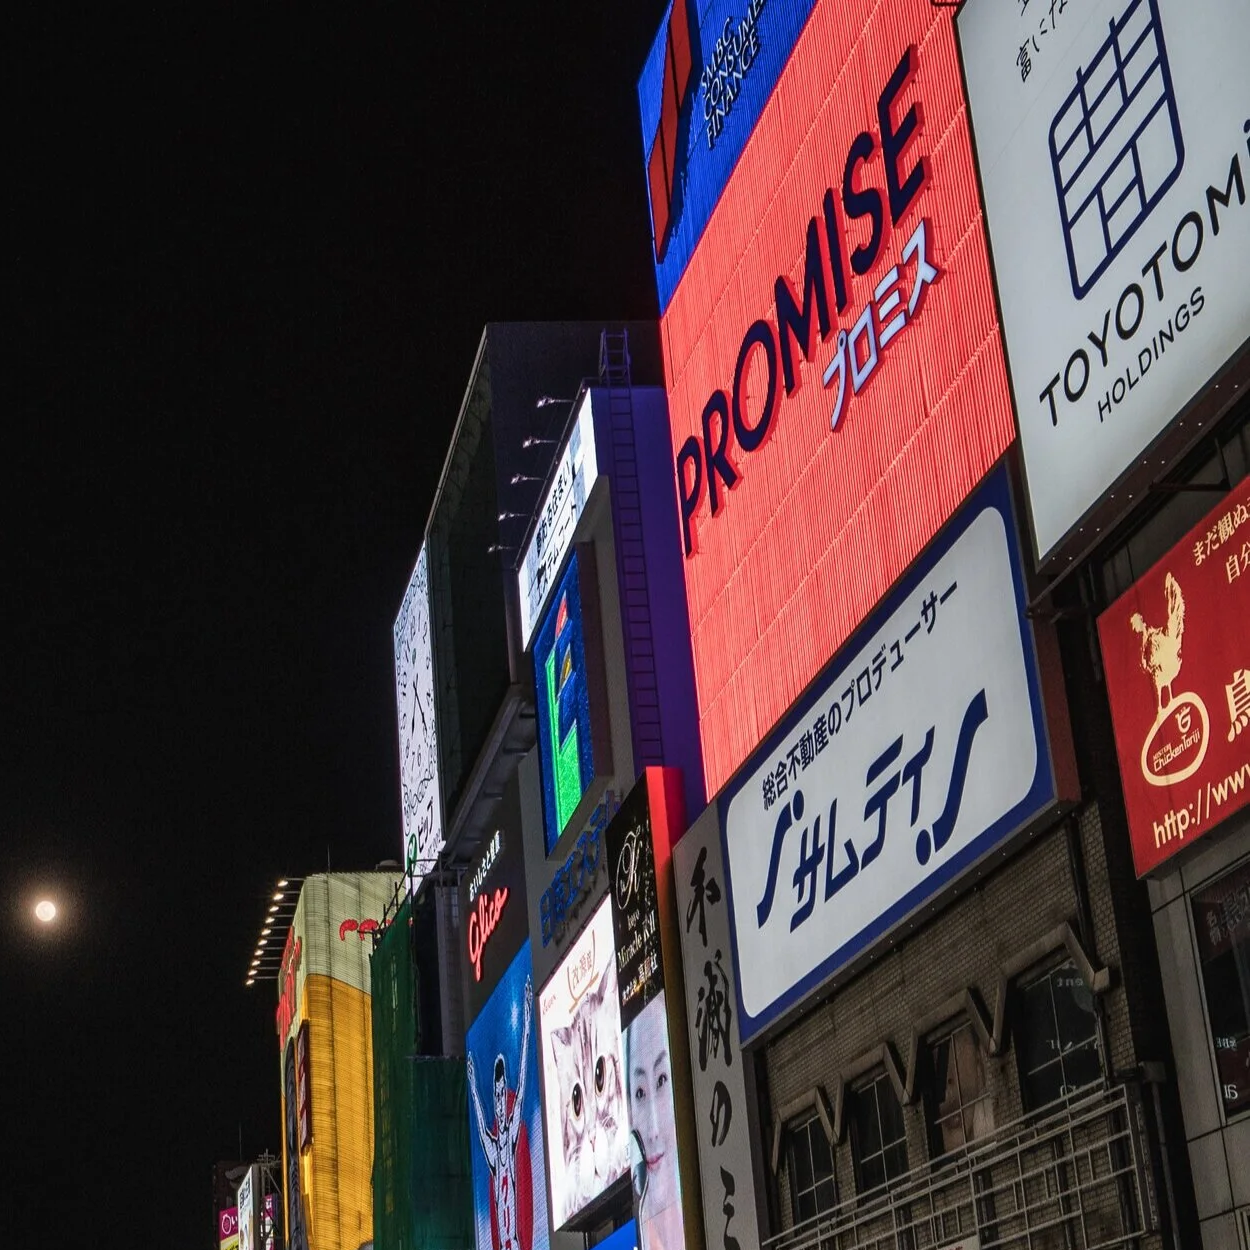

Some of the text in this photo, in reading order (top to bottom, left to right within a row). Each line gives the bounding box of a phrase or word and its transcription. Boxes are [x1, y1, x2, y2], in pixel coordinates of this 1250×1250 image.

[700, 17, 733, 98] SMBC
[706, 29, 758, 149] FINANCE
[677, 44, 931, 559] PROMISE
[822, 217, 940, 432] プロミス
[1097, 286, 1206, 423] HOLDINGS
[1193, 498, 1250, 566] まだ観ぬ
[761, 582, 958, 812] 総合不動産のプロデューサー
[469, 829, 502, 902] おいしさと健康
